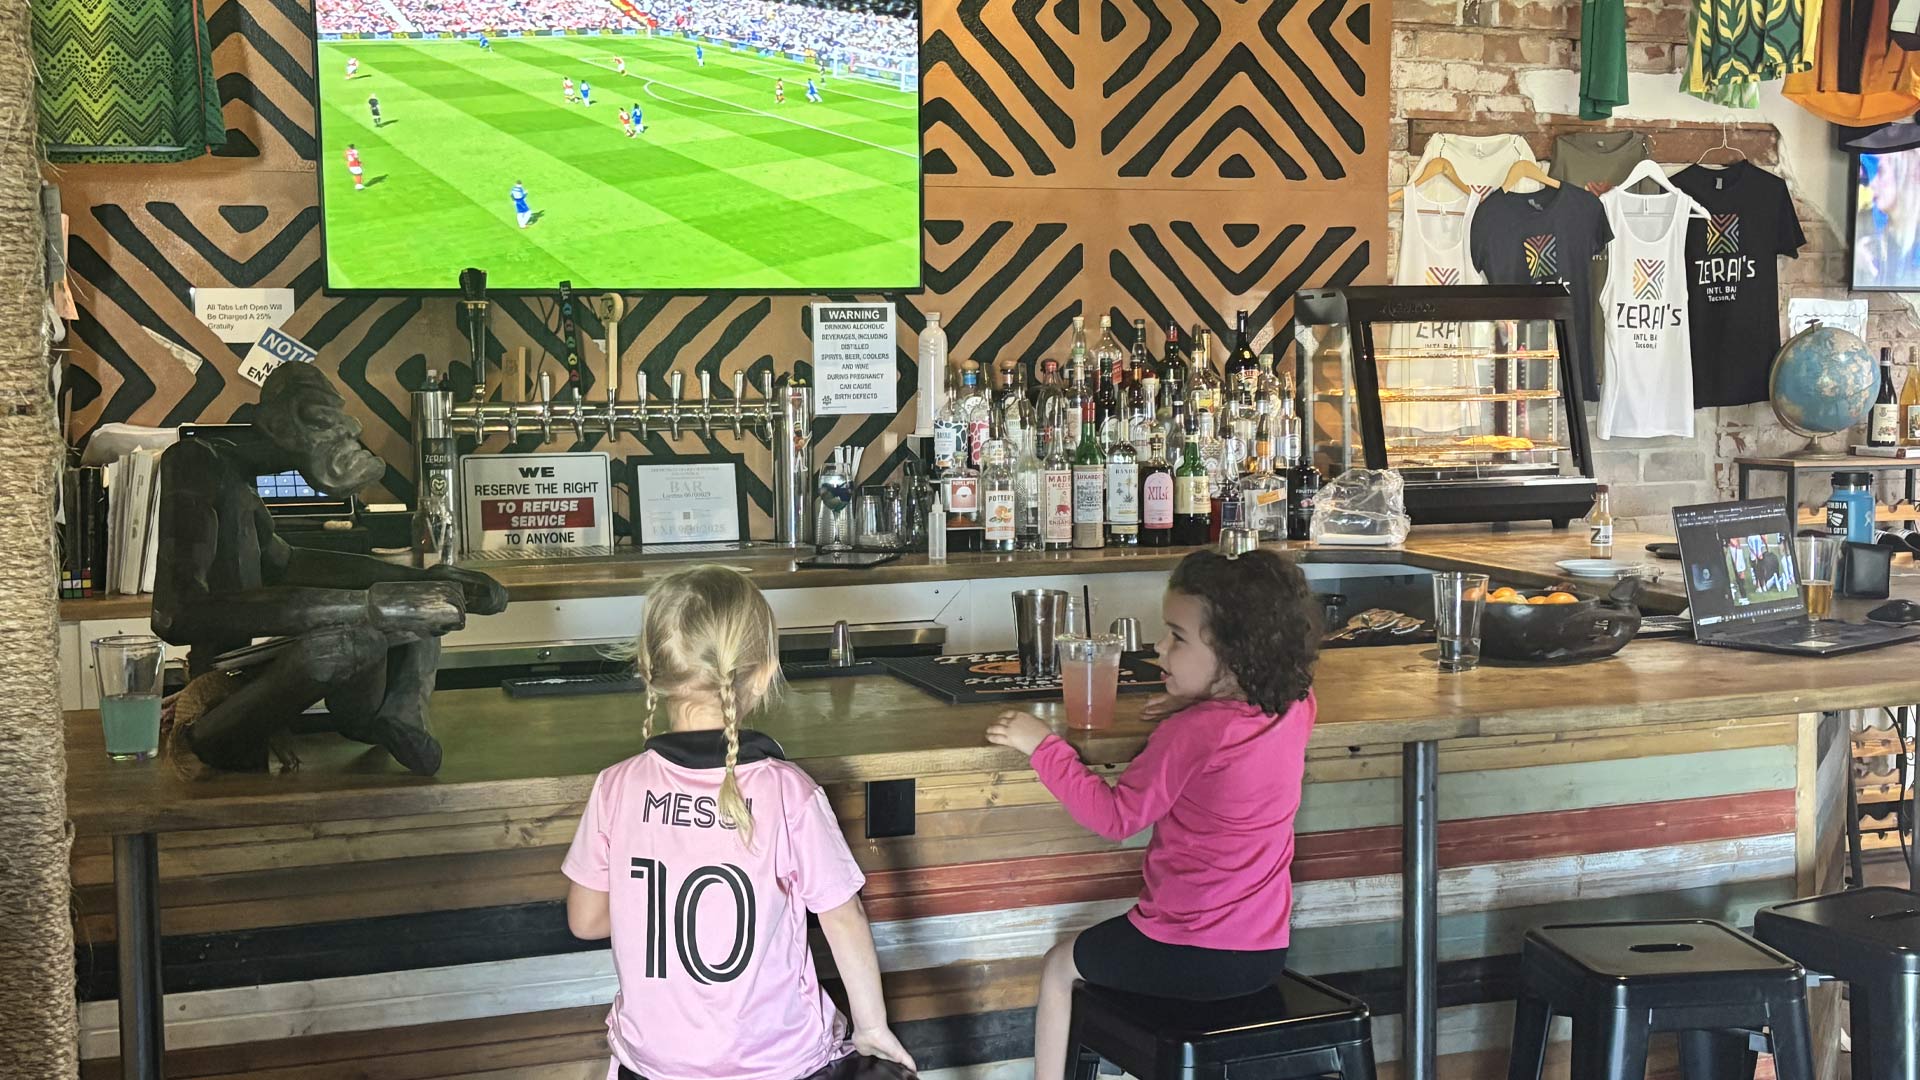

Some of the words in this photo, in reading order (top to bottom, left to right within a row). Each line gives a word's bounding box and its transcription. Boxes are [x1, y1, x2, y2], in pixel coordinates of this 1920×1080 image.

[1706, 286, 1723, 295] INTL
[249, 304, 268, 312] Open
[828, 310, 880, 320] WARNING
[208, 323, 234, 331] Gratuity
[262, 333, 317, 363] NOTI
[518, 466, 555, 478] WE
[474, 484, 530, 496] RESERVE
[535, 483, 558, 494] THE
[563, 482, 599, 494] RIGHT
[670, 481, 703, 493] BAR
[497, 502, 516, 513] TO
[522, 500, 579, 512] REFUSE
[510, 515, 566, 527] SERVICE
[505, 534, 521, 545] TO
[526, 531, 575, 545] ANYONE
[630, 857, 757, 986] 10
